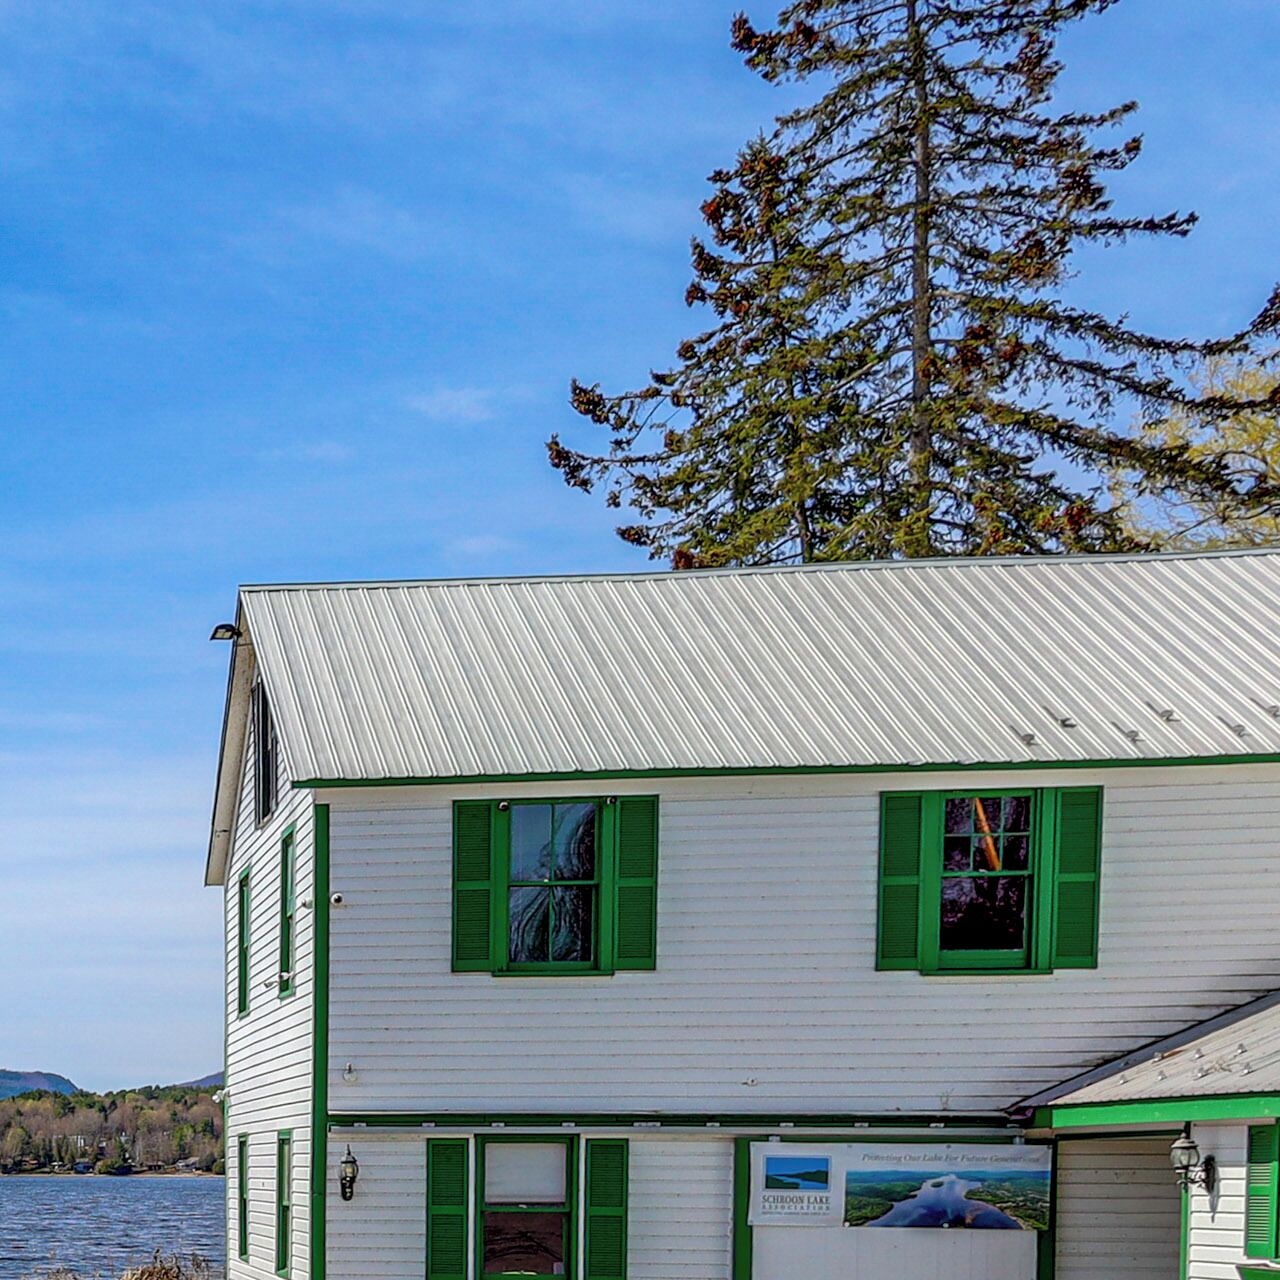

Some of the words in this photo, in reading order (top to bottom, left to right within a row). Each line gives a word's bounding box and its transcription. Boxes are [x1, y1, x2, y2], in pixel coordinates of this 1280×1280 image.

[862, 1153, 902, 1162] Protecting
[944, 1154, 959, 1162] For
[762, 1194, 805, 1205] SCHROON
[807, 1195, 831, 1205] LAKE
